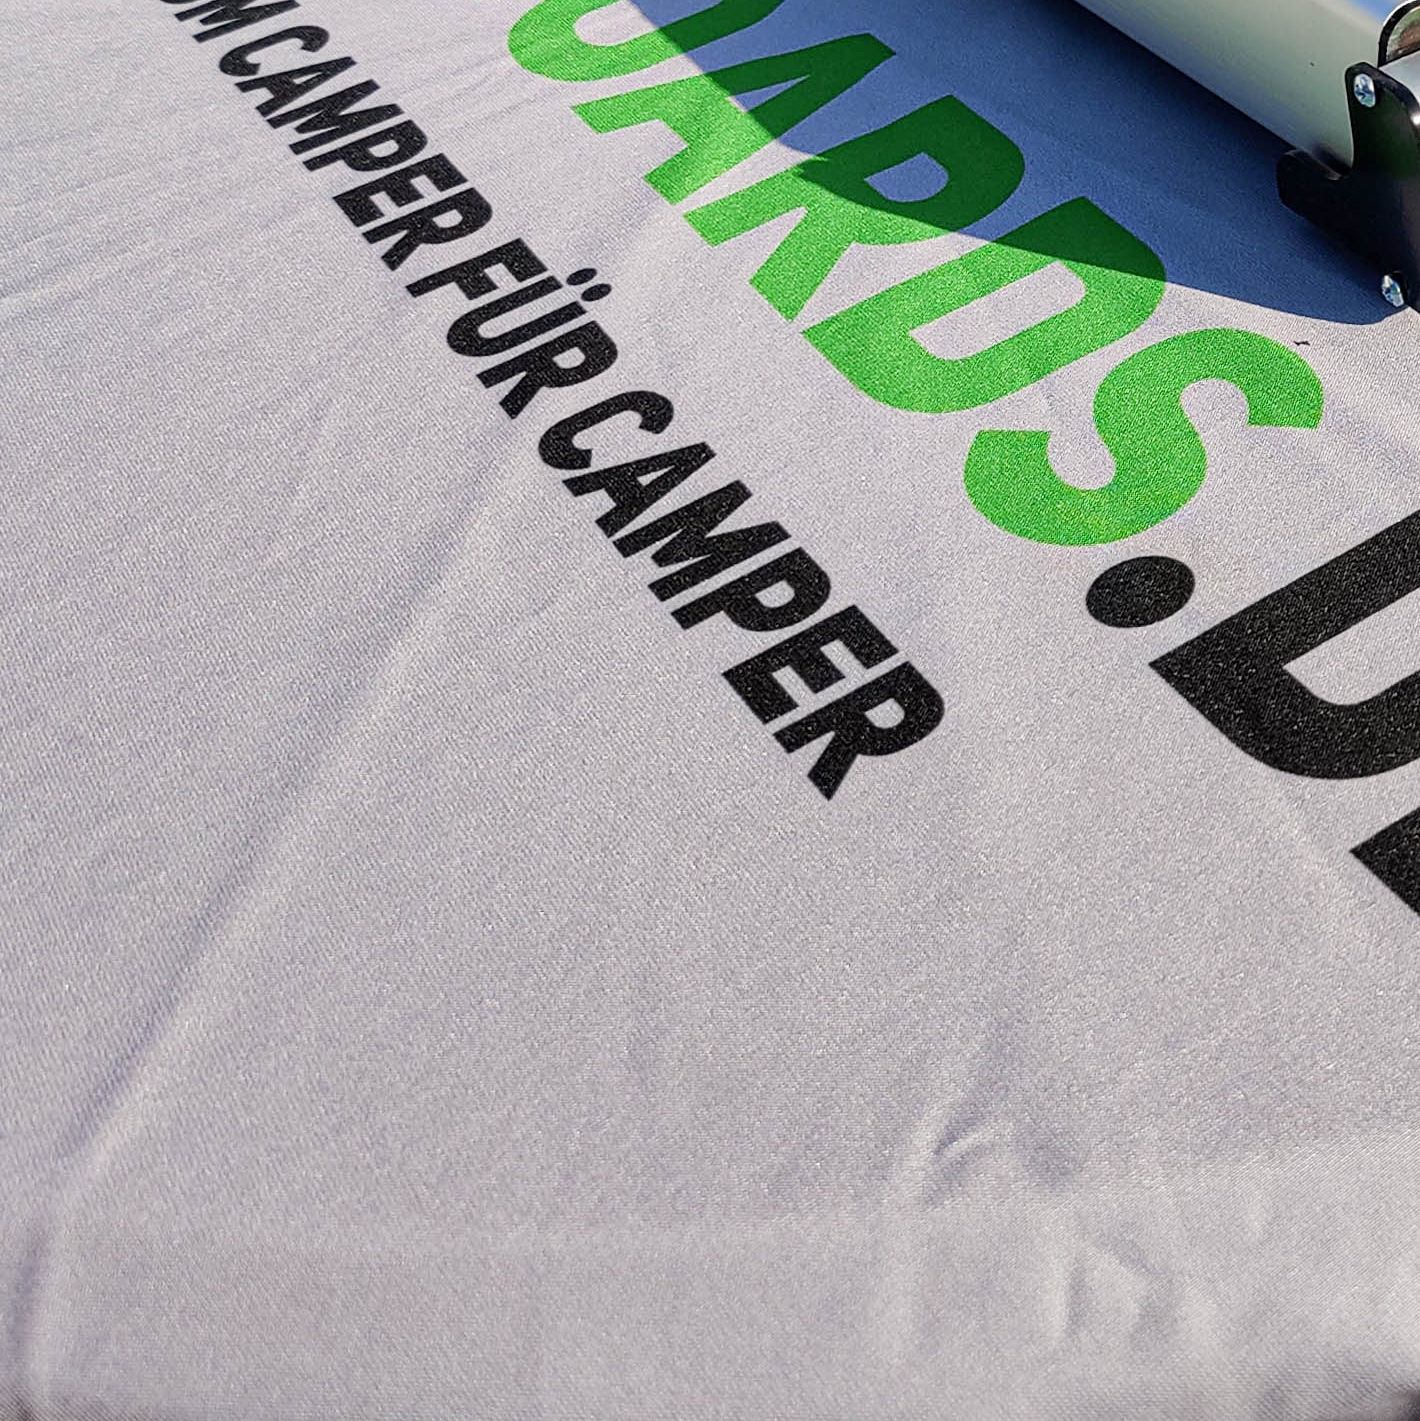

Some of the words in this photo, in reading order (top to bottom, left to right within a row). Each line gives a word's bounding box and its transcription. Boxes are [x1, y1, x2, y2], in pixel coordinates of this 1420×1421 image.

[219, 25, 493, 271] CAMPER
[406, 237, 618, 420] FÜR
[537, 390, 945, 801] CAMPER
